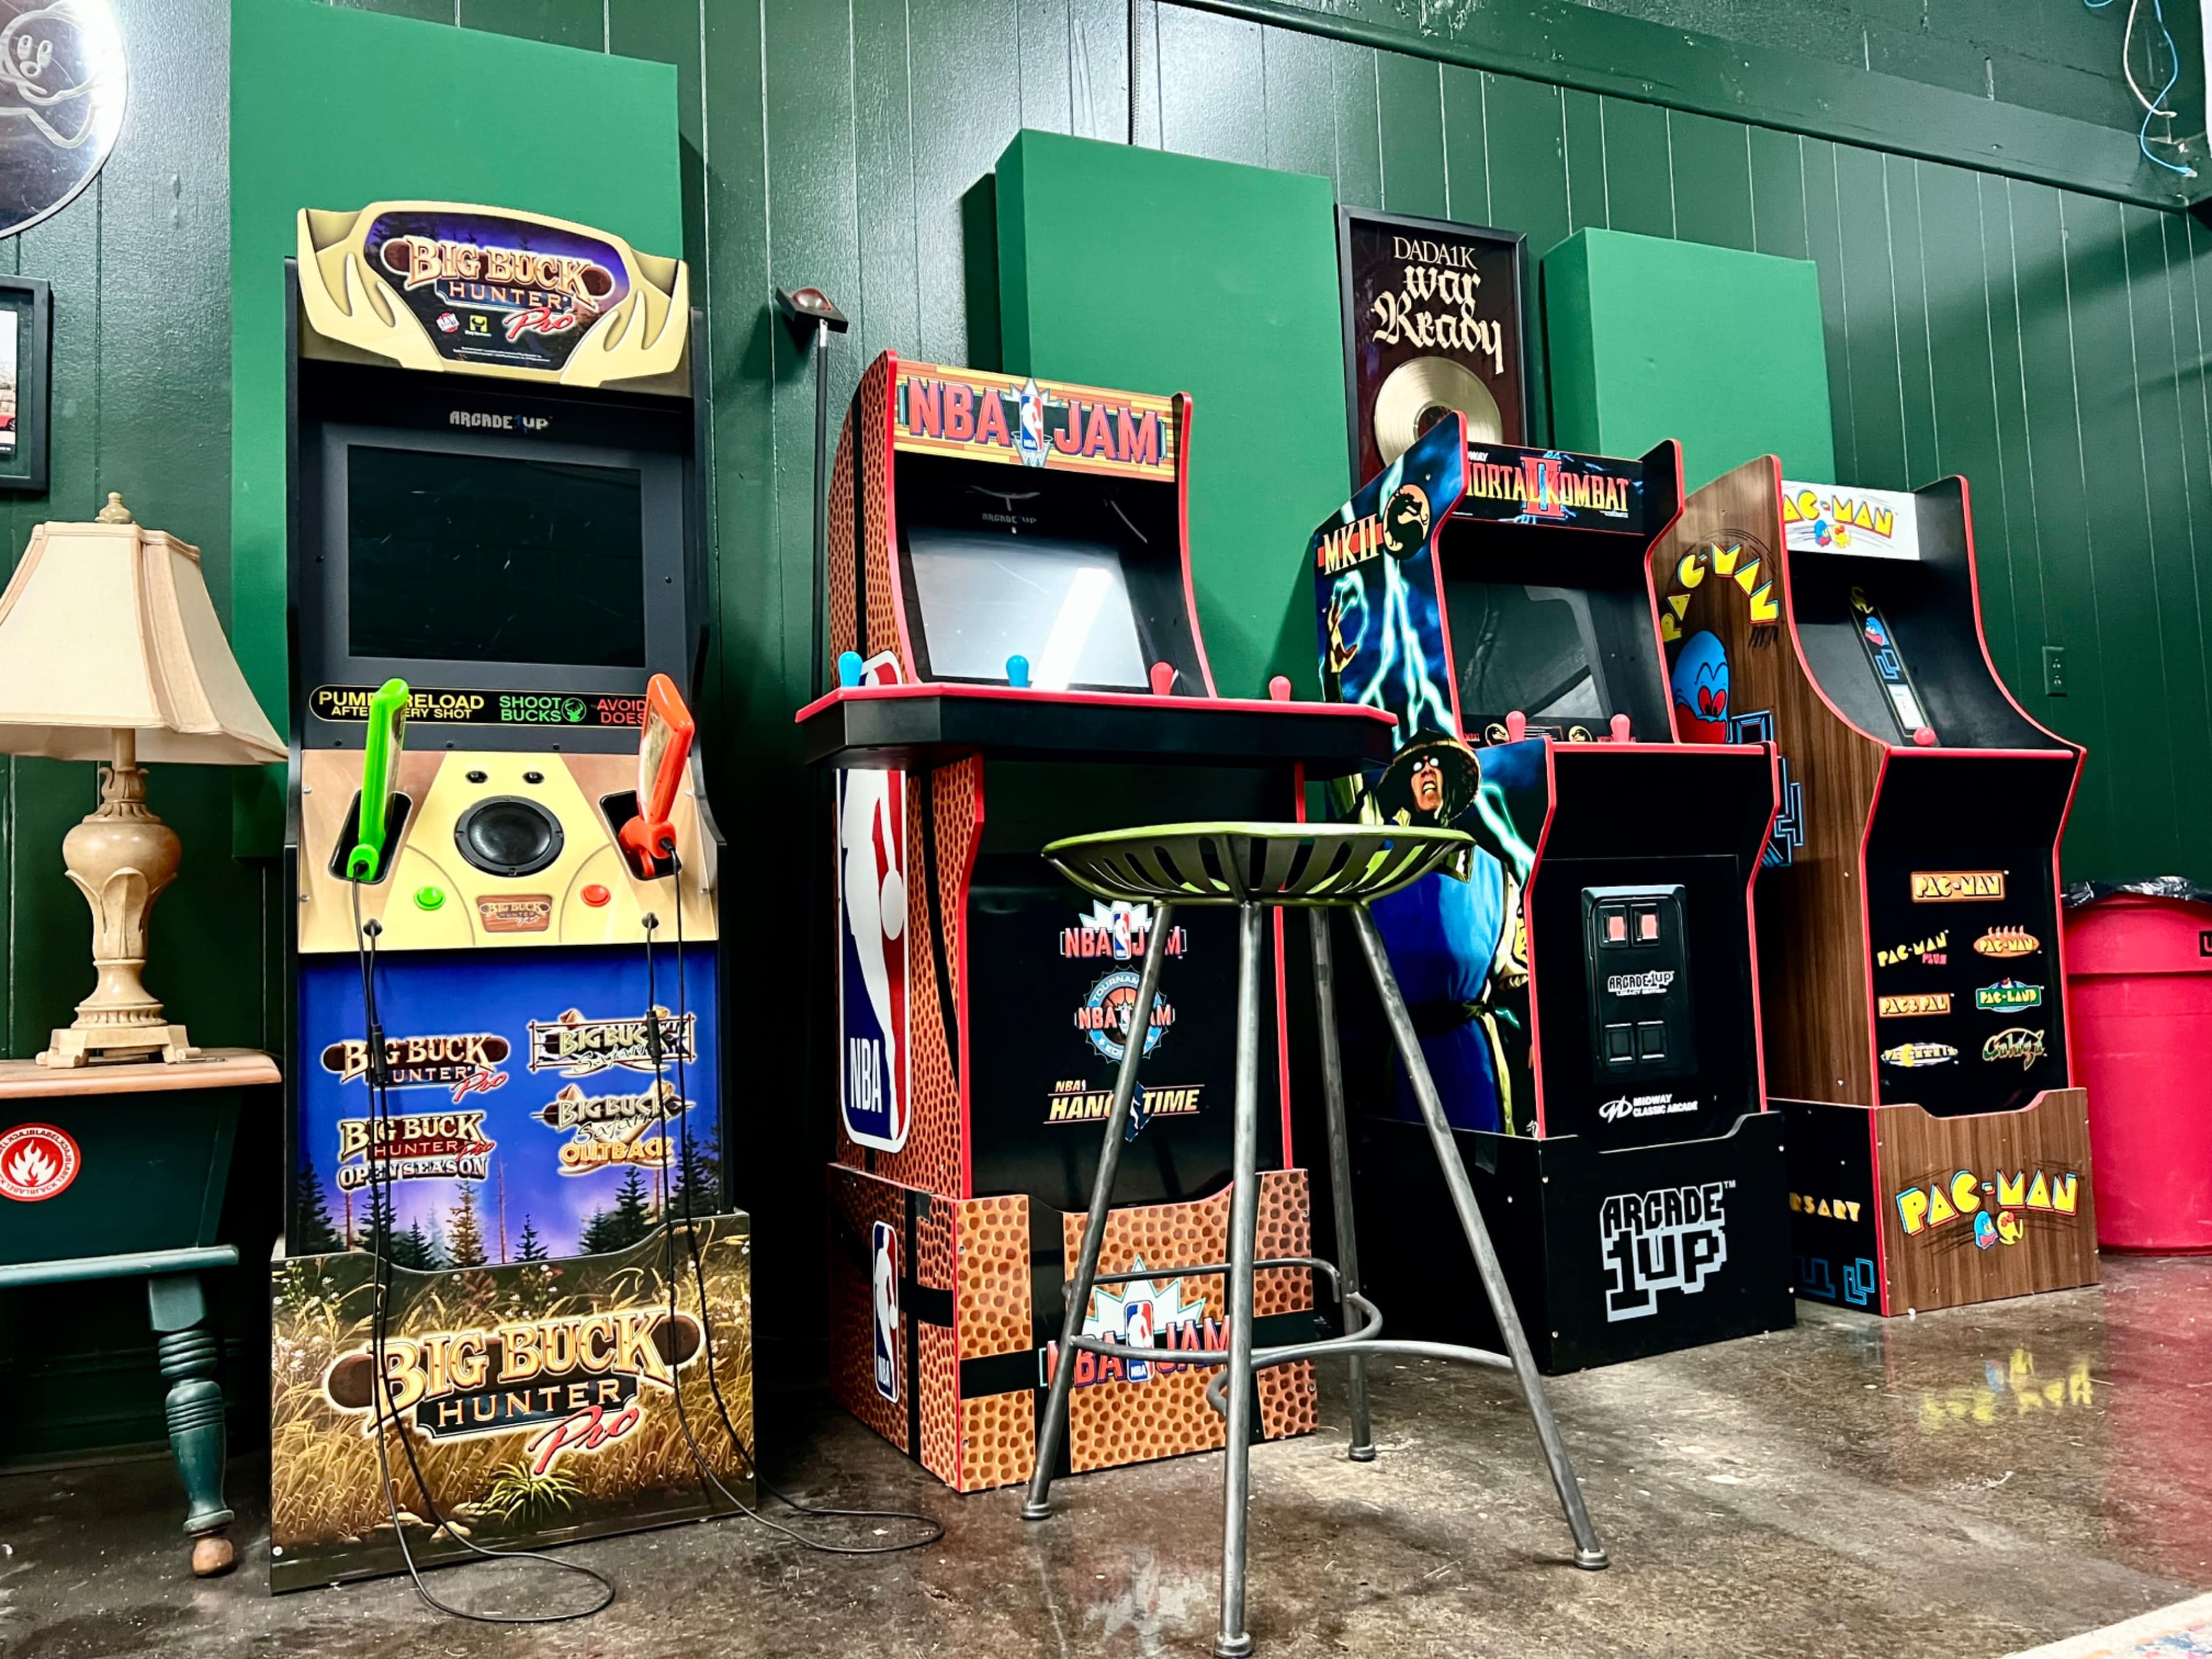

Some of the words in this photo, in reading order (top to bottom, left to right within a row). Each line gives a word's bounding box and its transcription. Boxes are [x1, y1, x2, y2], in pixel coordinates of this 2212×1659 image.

[1393, 235, 1479, 271] DADA1K
[406, 237, 480, 288] BIG
[486, 248, 599, 311] BUCK
[449, 280, 563, 309] HUNTER
[503, 306, 574, 341] Pro
[1370, 289, 1505, 376] Ready
[906, 376, 1013, 448] NBA
[1054, 399, 1160, 467] JAM
[1468, 450, 1488, 461] WAY
[1465, 461, 1540, 502] ORTAL
[1543, 469, 1630, 512] KOMBAT
[1783, 488, 1894, 539] AC-MAN
[1323, 513, 1380, 575] MKII
[1661, 541, 1780, 643] PAC-MAN
[331, 706, 369, 717] AFTE
[405, 708, 430, 718] ERY
[433, 709, 472, 719] SHOT
[501, 709, 562, 722] BUCKS
[499, 695, 562, 709] SHOOT
[597, 699, 647, 712] AVOID
[1914, 874, 2001, 897] PAC-MAN
[510, 902, 547, 916] BUCK
[1065, 927, 1112, 959] NBA
[1132, 926, 1181, 956] JM
[1877, 931, 1947, 967] PAC-MAN
[1979, 938, 2035, 953] PAC-MAN
[1922, 995, 1949, 1012] PAL
[1980, 989, 2036, 1004] PAC-LAND
[1078, 1006, 1118, 1029] NBA
[560, 1029, 600, 1056] BIG
[604, 1024, 649, 1047] BUC
[341, 1041, 400, 1083] BG
[406, 1035, 495, 1073] BUCK
[392, 1066, 468, 1083] UNTER
[850, 1037, 882, 1113] NBA
[450, 1072, 508, 1102] Pro
[1055, 1080, 1081, 1092] NBA
[1141, 1089, 1200, 1114] TIME
[1633, 1093, 1673, 1107] MIDWAY
[558, 1099, 601, 1130] BIG
[605, 1096, 673, 1120] BUCK
[1633, 1105, 1666, 1118] CLASSIC
[1666, 1100, 1699, 1113] ARCADE
[342, 1120, 396, 1157] BIG
[402, 1113, 486, 1145] BUCK
[374, 1141, 459, 1156] HUNTER
[559, 1137, 675, 1165] OUTBACK
[401, 1157, 487, 1180] SEASON
[1600, 1181, 1725, 1240] ARCADE
[1789, 1192, 1861, 1222] RSARY
[1896, 1169, 2078, 1237] PAC-MAN
[368, 1333, 487, 1432] BIG
[499, 1309, 673, 1387] BUCK
[438, 1379, 622, 1427] HUNTER
[529, 1406, 639, 1475] Pro
